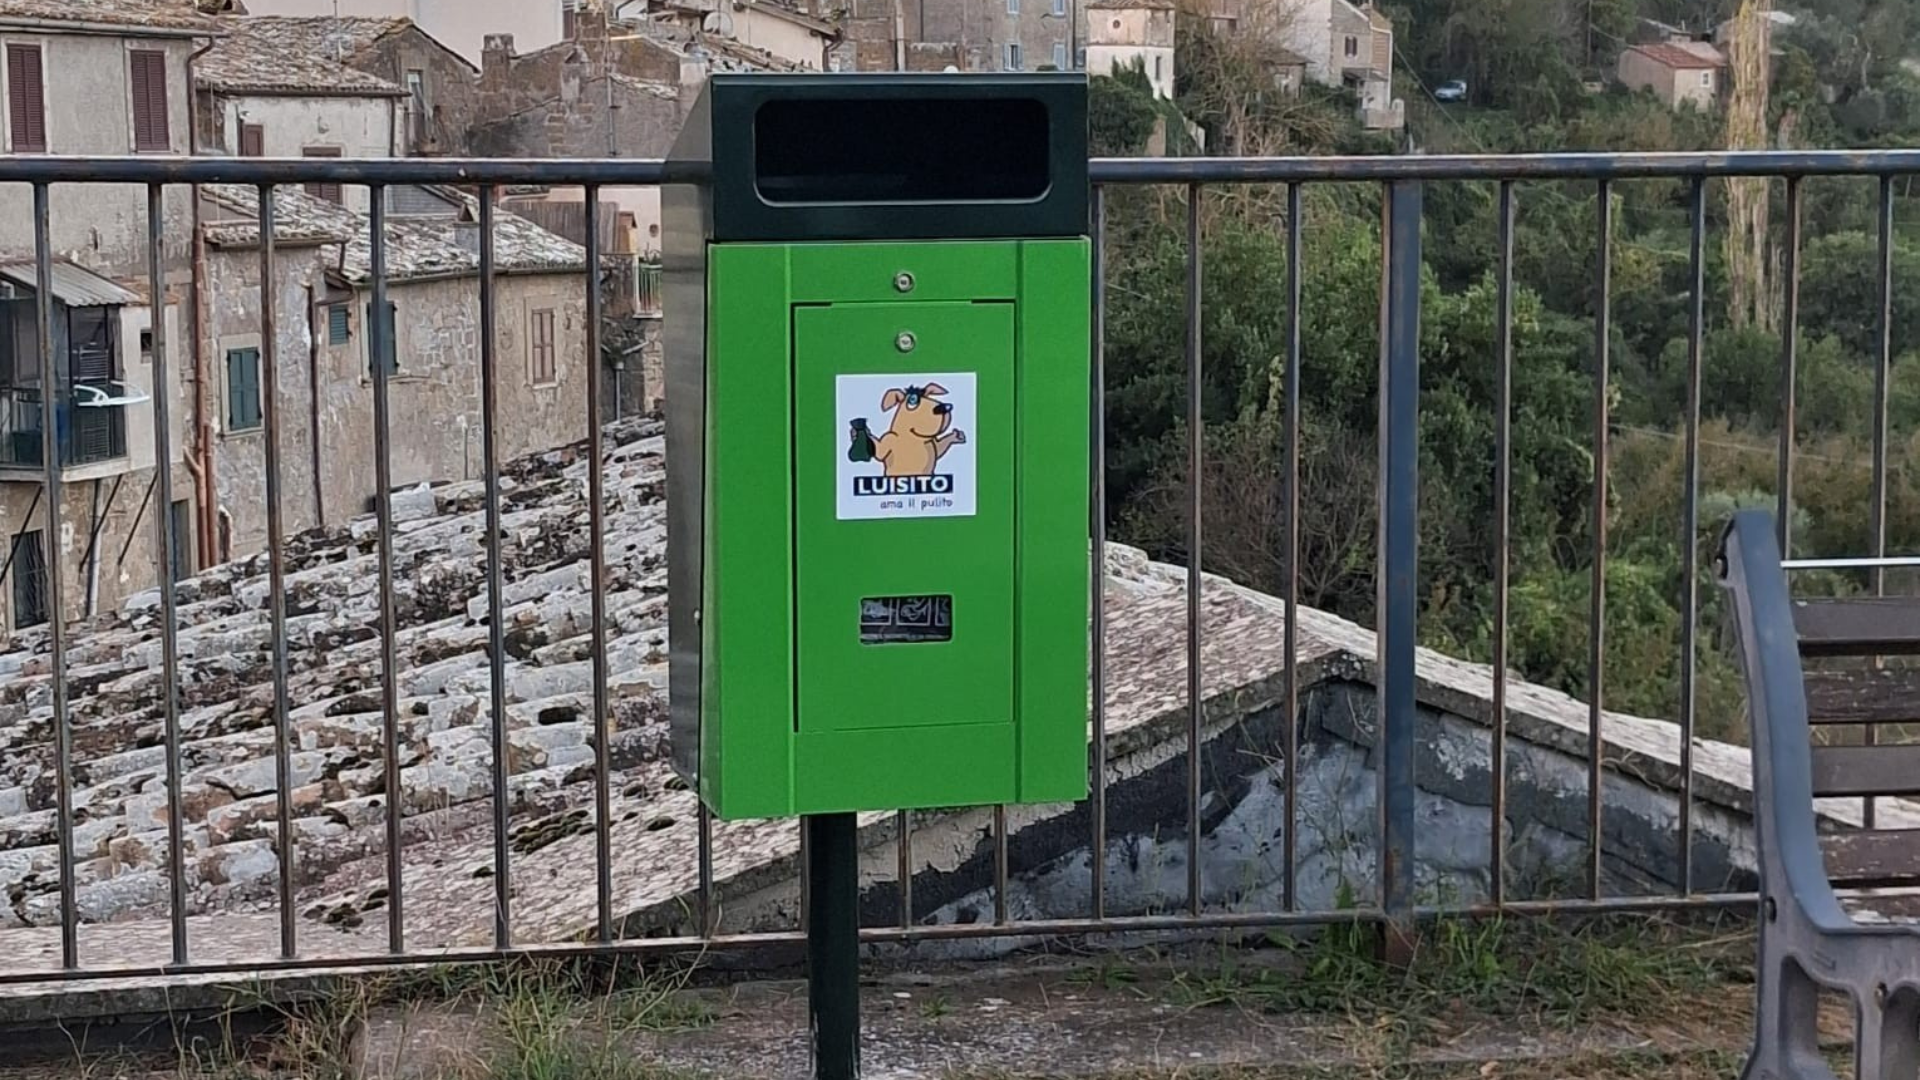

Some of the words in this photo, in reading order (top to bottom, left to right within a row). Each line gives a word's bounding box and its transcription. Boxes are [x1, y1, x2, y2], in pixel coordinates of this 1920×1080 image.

[858, 476, 949, 494] LUISITO
[880, 500, 903, 509] ama
[908, 498, 915, 508] il
[921, 498, 953, 511] pulito
